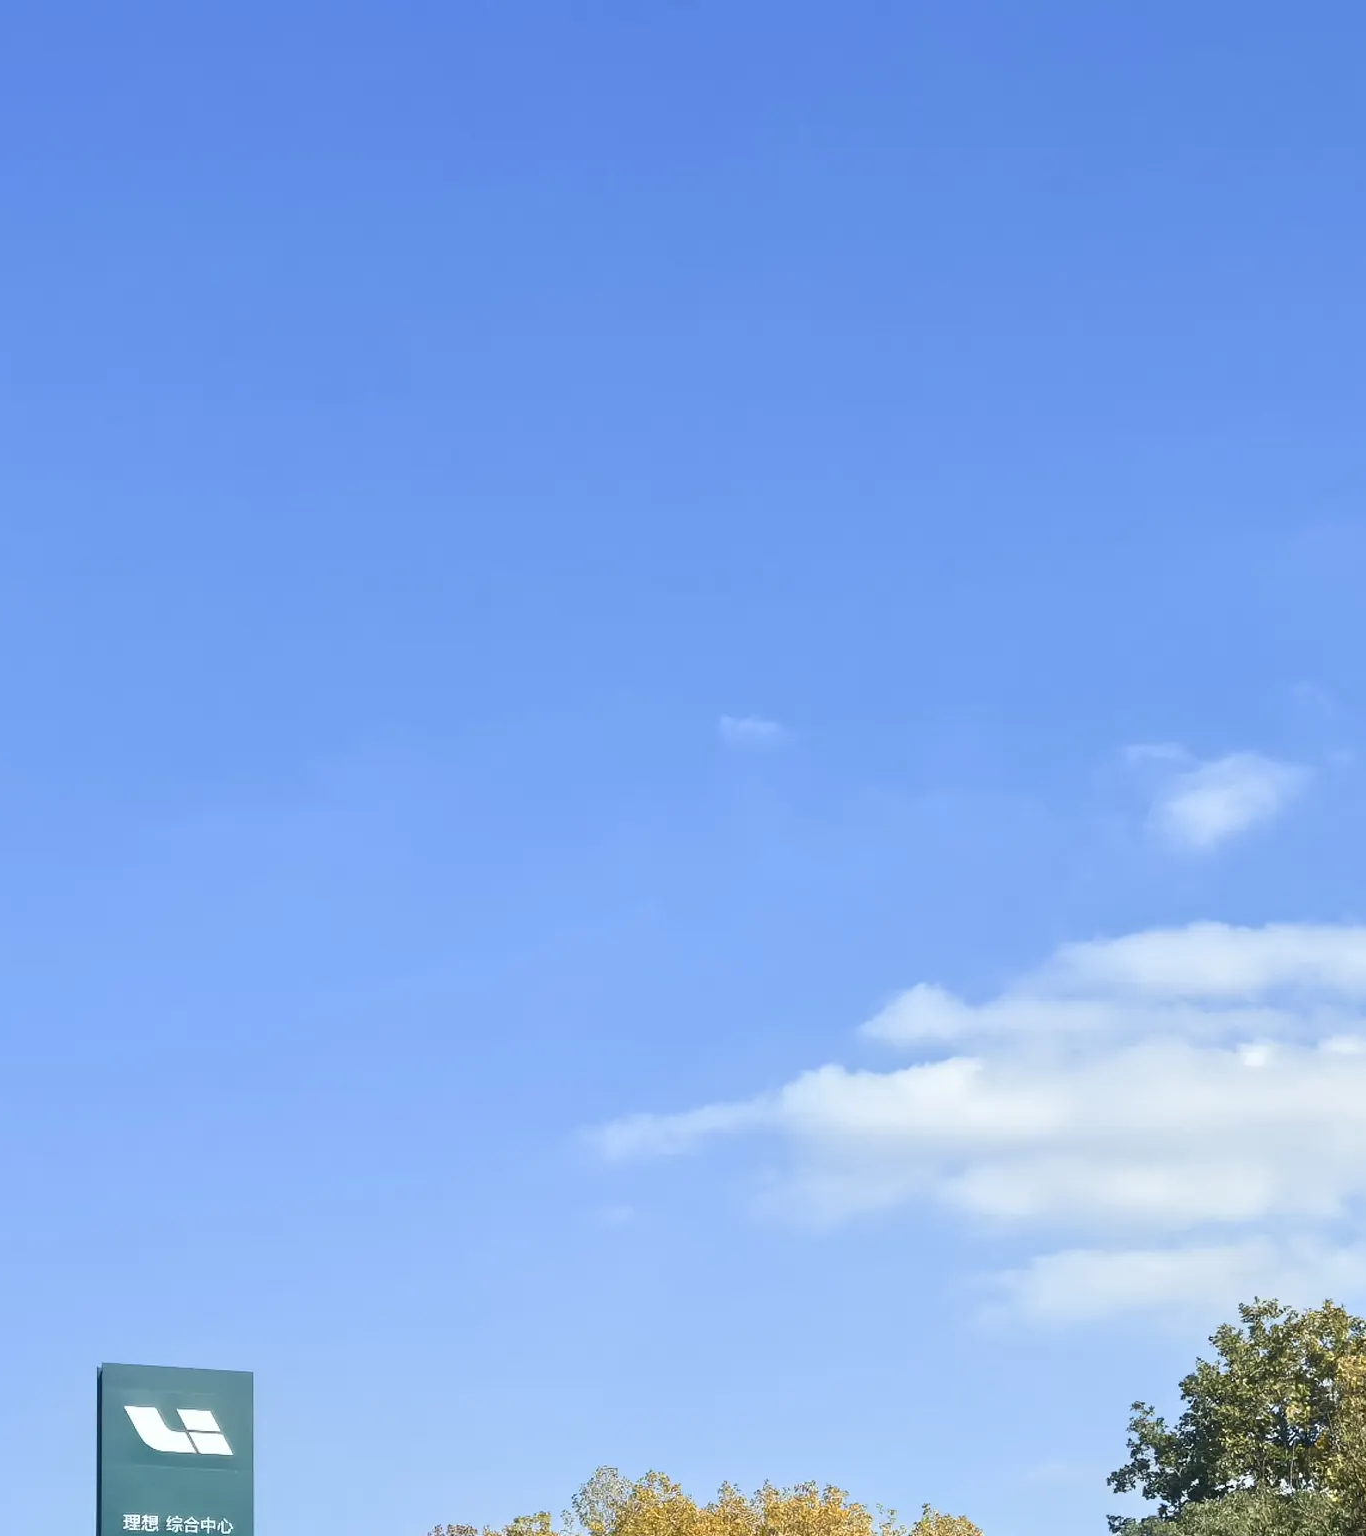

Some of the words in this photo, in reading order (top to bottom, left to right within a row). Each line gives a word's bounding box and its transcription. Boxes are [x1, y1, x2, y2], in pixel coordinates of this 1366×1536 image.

[122, 1513, 159, 1532] 理想
[166, 1515, 234, 1535] 综合中心
